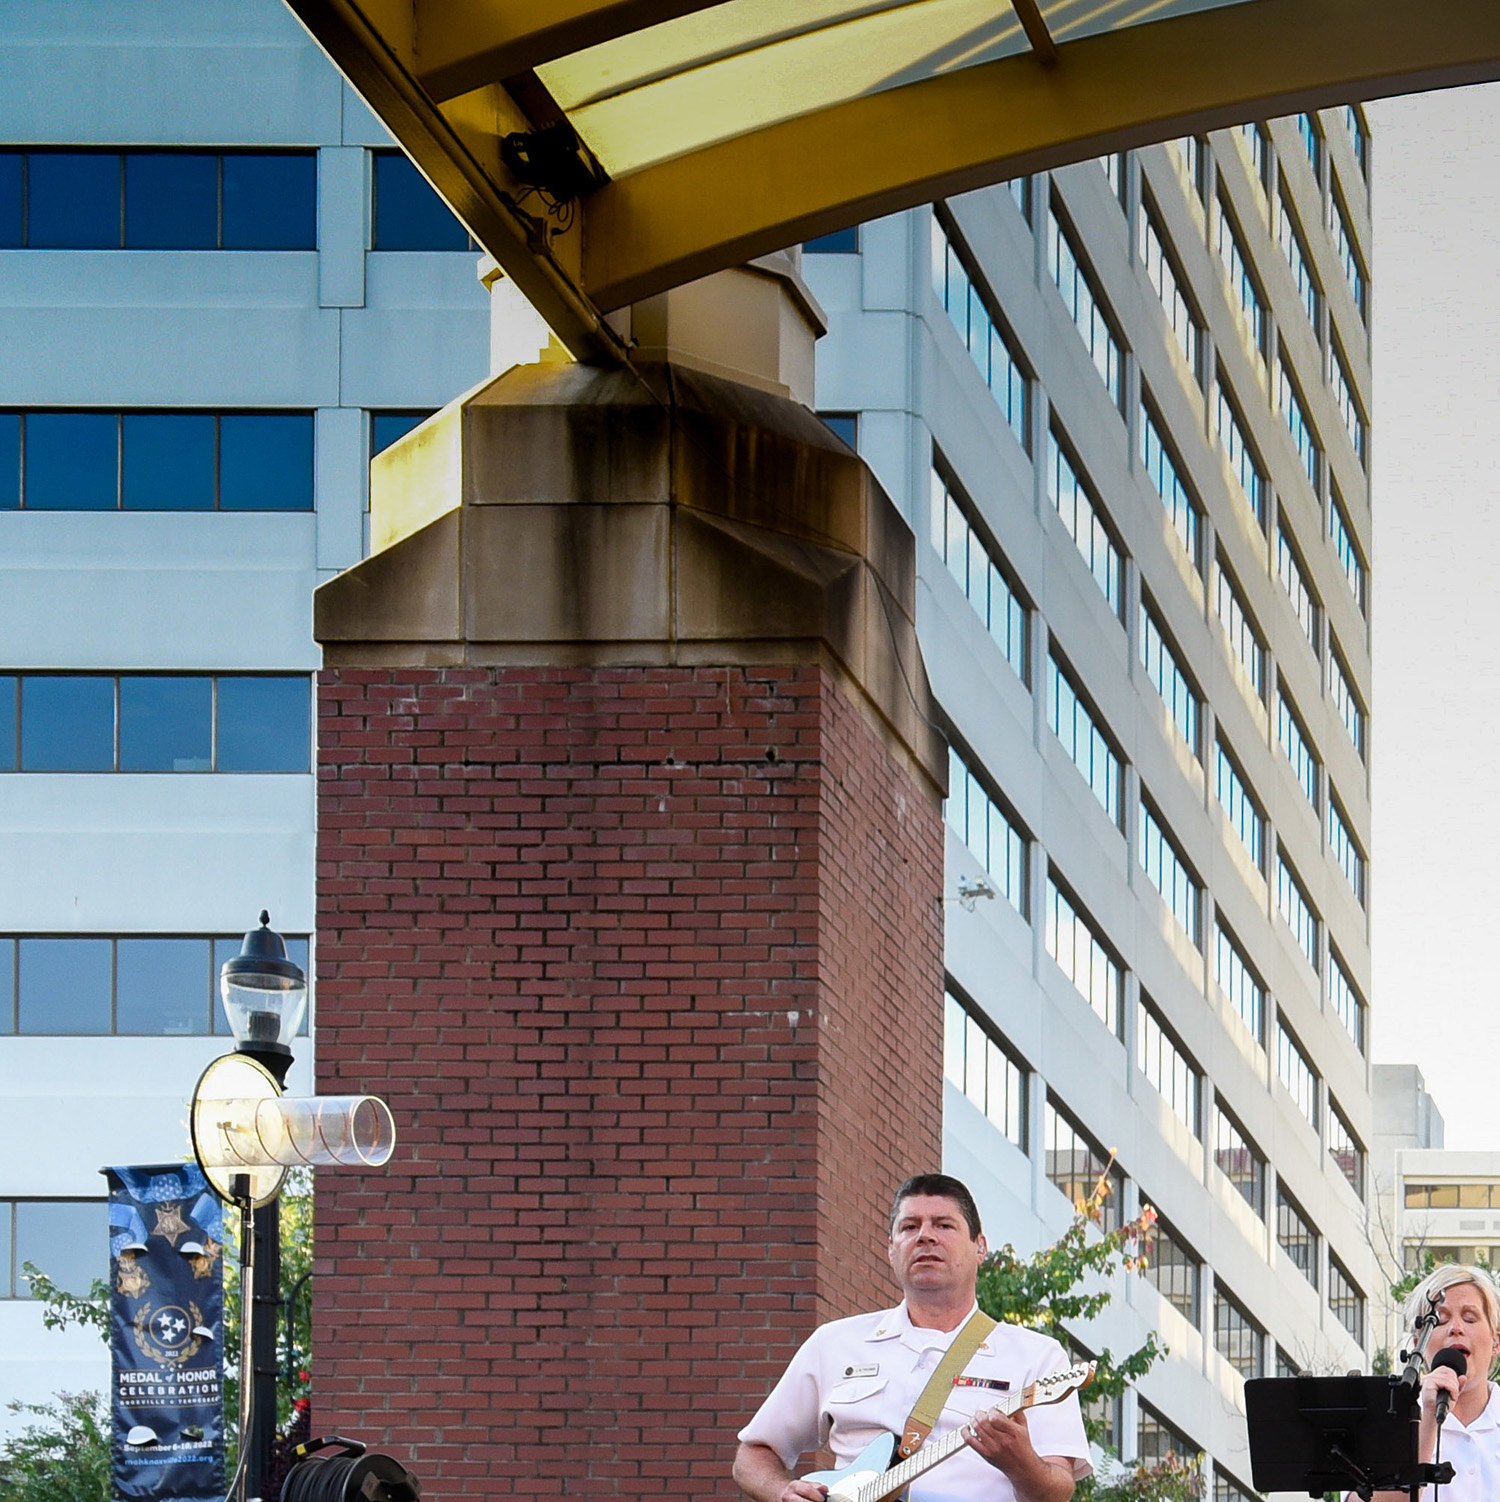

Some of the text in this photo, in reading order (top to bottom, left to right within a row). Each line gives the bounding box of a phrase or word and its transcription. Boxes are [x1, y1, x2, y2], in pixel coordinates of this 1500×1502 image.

[119, 1369, 217, 1384] MEDAL of HONOR
[119, 1383, 219, 1397] CELEBRATION
[123, 1443, 172, 1454] September
[192, 1440, 213, 1450] 2022
[124, 1455, 214, 1466] mohknoxville2022.org
